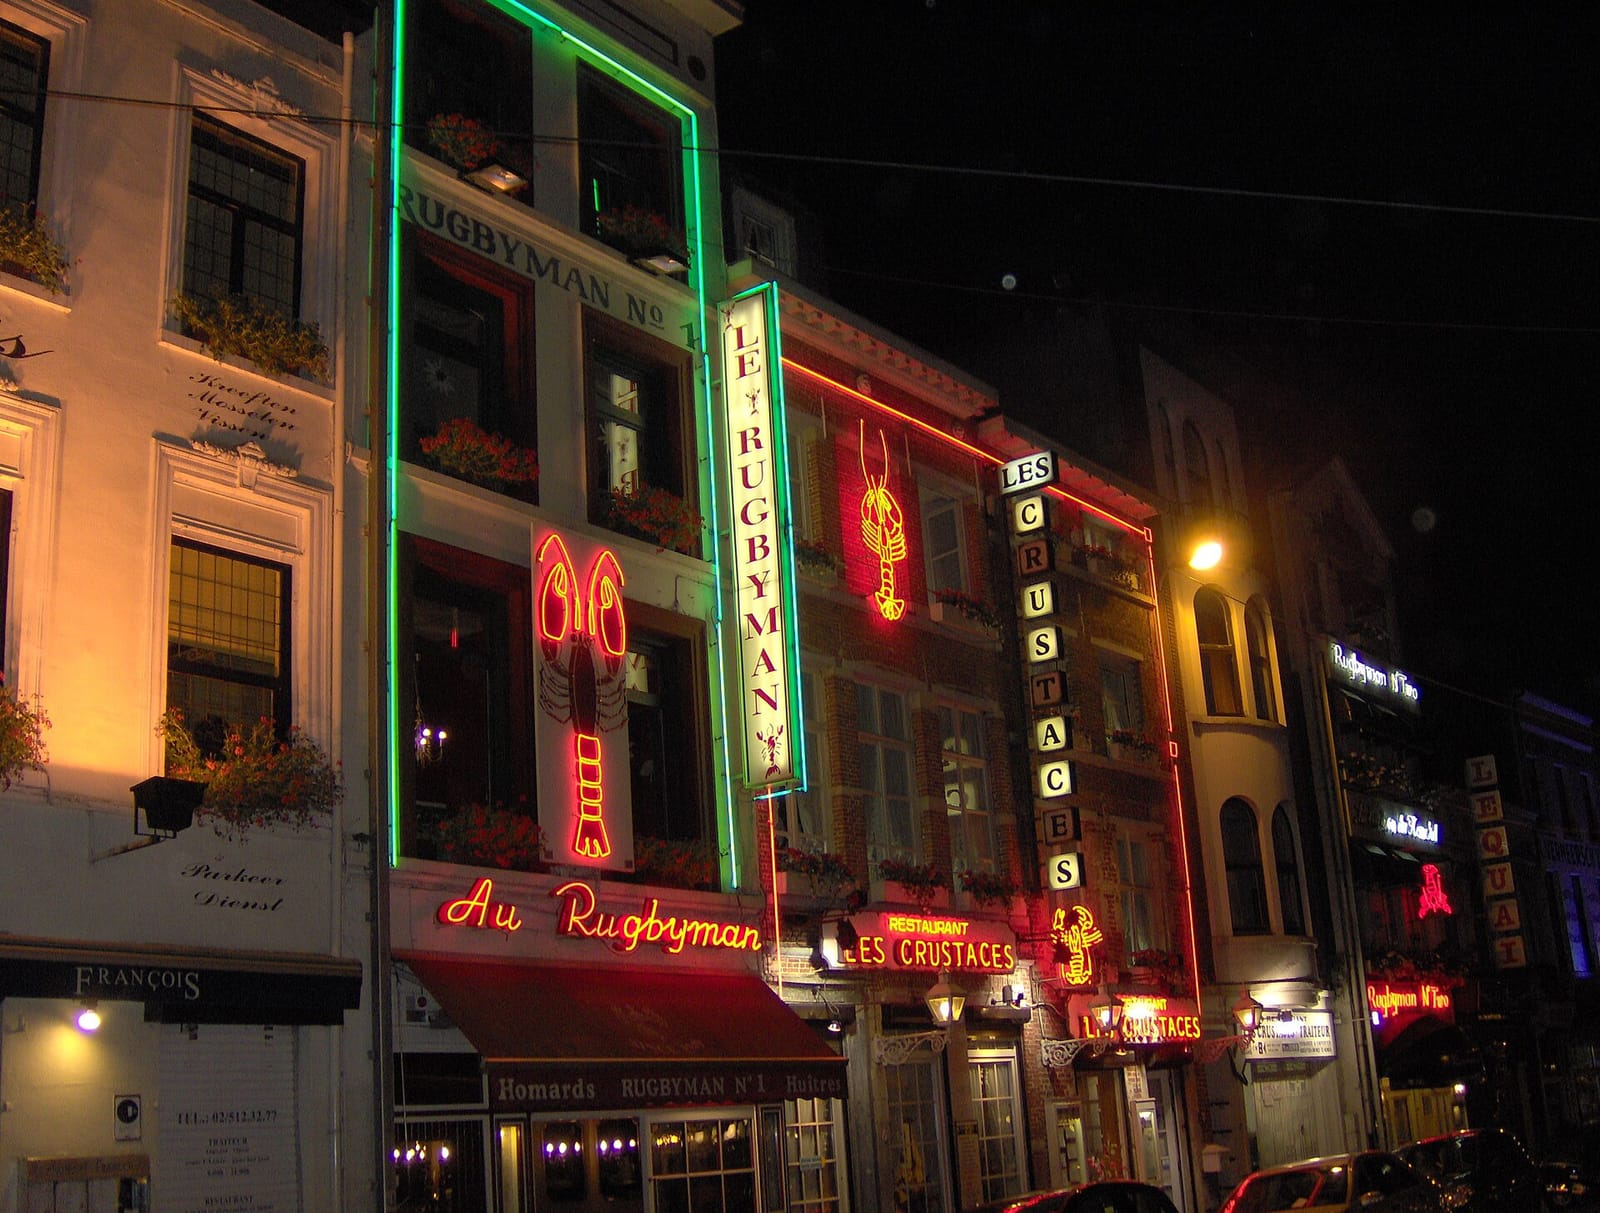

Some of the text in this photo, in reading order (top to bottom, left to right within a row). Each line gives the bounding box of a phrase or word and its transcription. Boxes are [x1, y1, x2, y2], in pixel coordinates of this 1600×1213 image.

[398, 184, 609, 308] RUGBYMAN
[734, 323, 761, 380] LE
[1001, 457, 1050, 489] LES
[737, 426, 780, 717] RUGBYMAN
[1021, 503, 1073, 884] CRUSTACES
[439, 877, 762, 954] Au Rugbyman
[888, 917, 969, 936] RESTAURANT
[899, 938, 1015, 969] CRUSTACES
[74, 966, 200, 1000] FRANÇOIS
[1367, 984, 1417, 1018] Rugbyman
[1430, 985, 1449, 1009] Two
[1121, 1015, 1200, 1039] CRUSTACES
[499, 1077, 596, 1100] Homards
[621, 1075, 725, 1098] RUGBYMAN
